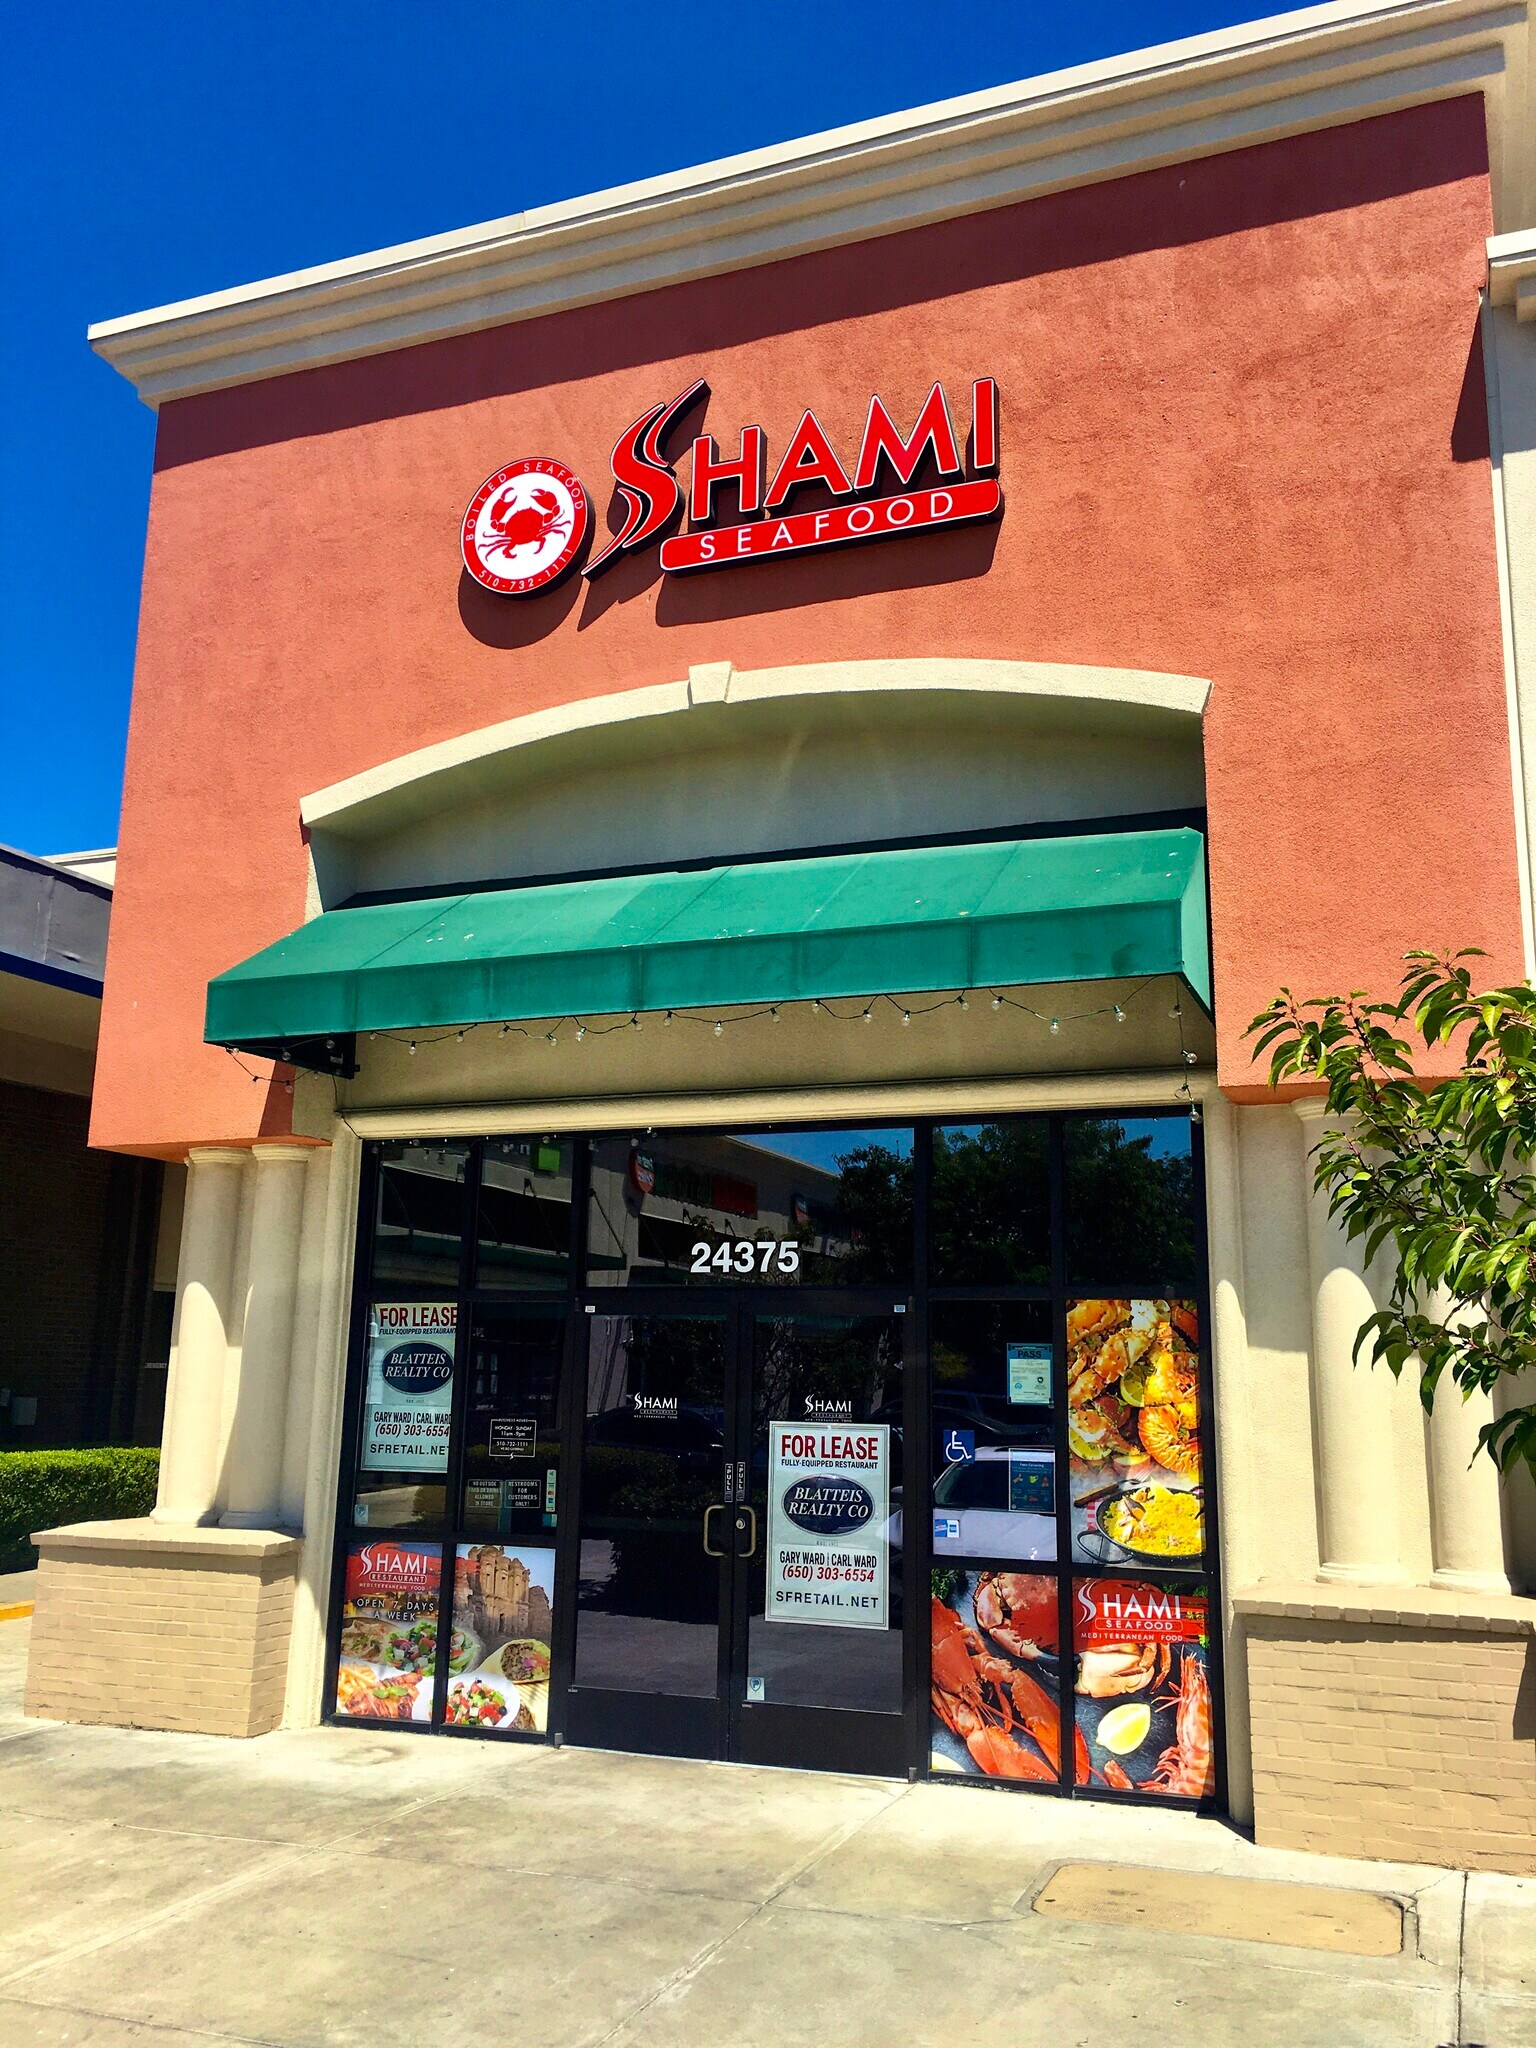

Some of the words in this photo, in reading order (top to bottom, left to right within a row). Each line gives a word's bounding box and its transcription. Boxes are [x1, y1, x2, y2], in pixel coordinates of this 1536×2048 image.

[580, 377, 996, 576] SHAMI
[465, 473, 507, 542] BOILED
[523, 461, 584, 510] SEAFOOD
[700, 491, 955, 560] SEAFOOD
[478, 548, 573, 591] 510-732-1111
[690, 1241, 799, 1273] 24375
[379, 1308, 408, 1327] FOR
[412, 1307, 457, 1327] LEASE
[379, 1327, 422, 1336] FULLY-EQUIPPED
[390, 1353, 446, 1365] BLATTEIS
[1017, 1350, 1042, 1359] PASS
[385, 1366, 431, 1378] REALTY
[432, 1366, 450, 1378] CO
[633, 1391, 678, 1411] SHAMI
[802, 1393, 852, 1416] SHAMI
[374, 1411, 392, 1423] GARY
[393, 1412, 412, 1423] WARD
[416, 1413, 433, 1424] CARL
[375, 1423, 401, 1438] (650)
[404, 1425, 450, 1437] 303-6554
[781, 1435, 816, 1458] FOR
[821, 1436, 879, 1460] LEASE
[781, 1459, 834, 1468] FULLY-EQUIPPED
[835, 1461, 879, 1470] RESTAURANT
[794, 1487, 864, 1503] BLATTEIS
[788, 1501, 845, 1516] REALTY
[847, 1504, 869, 1518] CO
[356, 1543, 427, 1579] SHAMI
[779, 1550, 801, 1564] GARY
[803, 1552, 825, 1565] WARD
[831, 1553, 852, 1567] CARL
[854, 1555, 877, 1568] WARD
[371, 1575, 425, 1583] RESTAURANT
[782, 1564, 813, 1582] (650)
[816, 1567, 875, 1583] 303-6554
[359, 1582, 407, 1590] MEDITERRANEAN
[356, 1598, 385, 1608] OPEN
[393, 1601, 399, 1609] 7
[406, 1601, 434, 1611] DAYS
[775, 1591, 879, 1609] SFRETAIL.NET
[1076, 1579, 1181, 1628] SHAMI
[373, 1611, 380, 1619] A
[387, 1611, 416, 1621] WEEK
[1105, 1620, 1173, 1630] SEAFOOD
[1080, 1632, 1154, 1641] MEDITERRANEAN
[1161, 1634, 1183, 1642] FOOD
